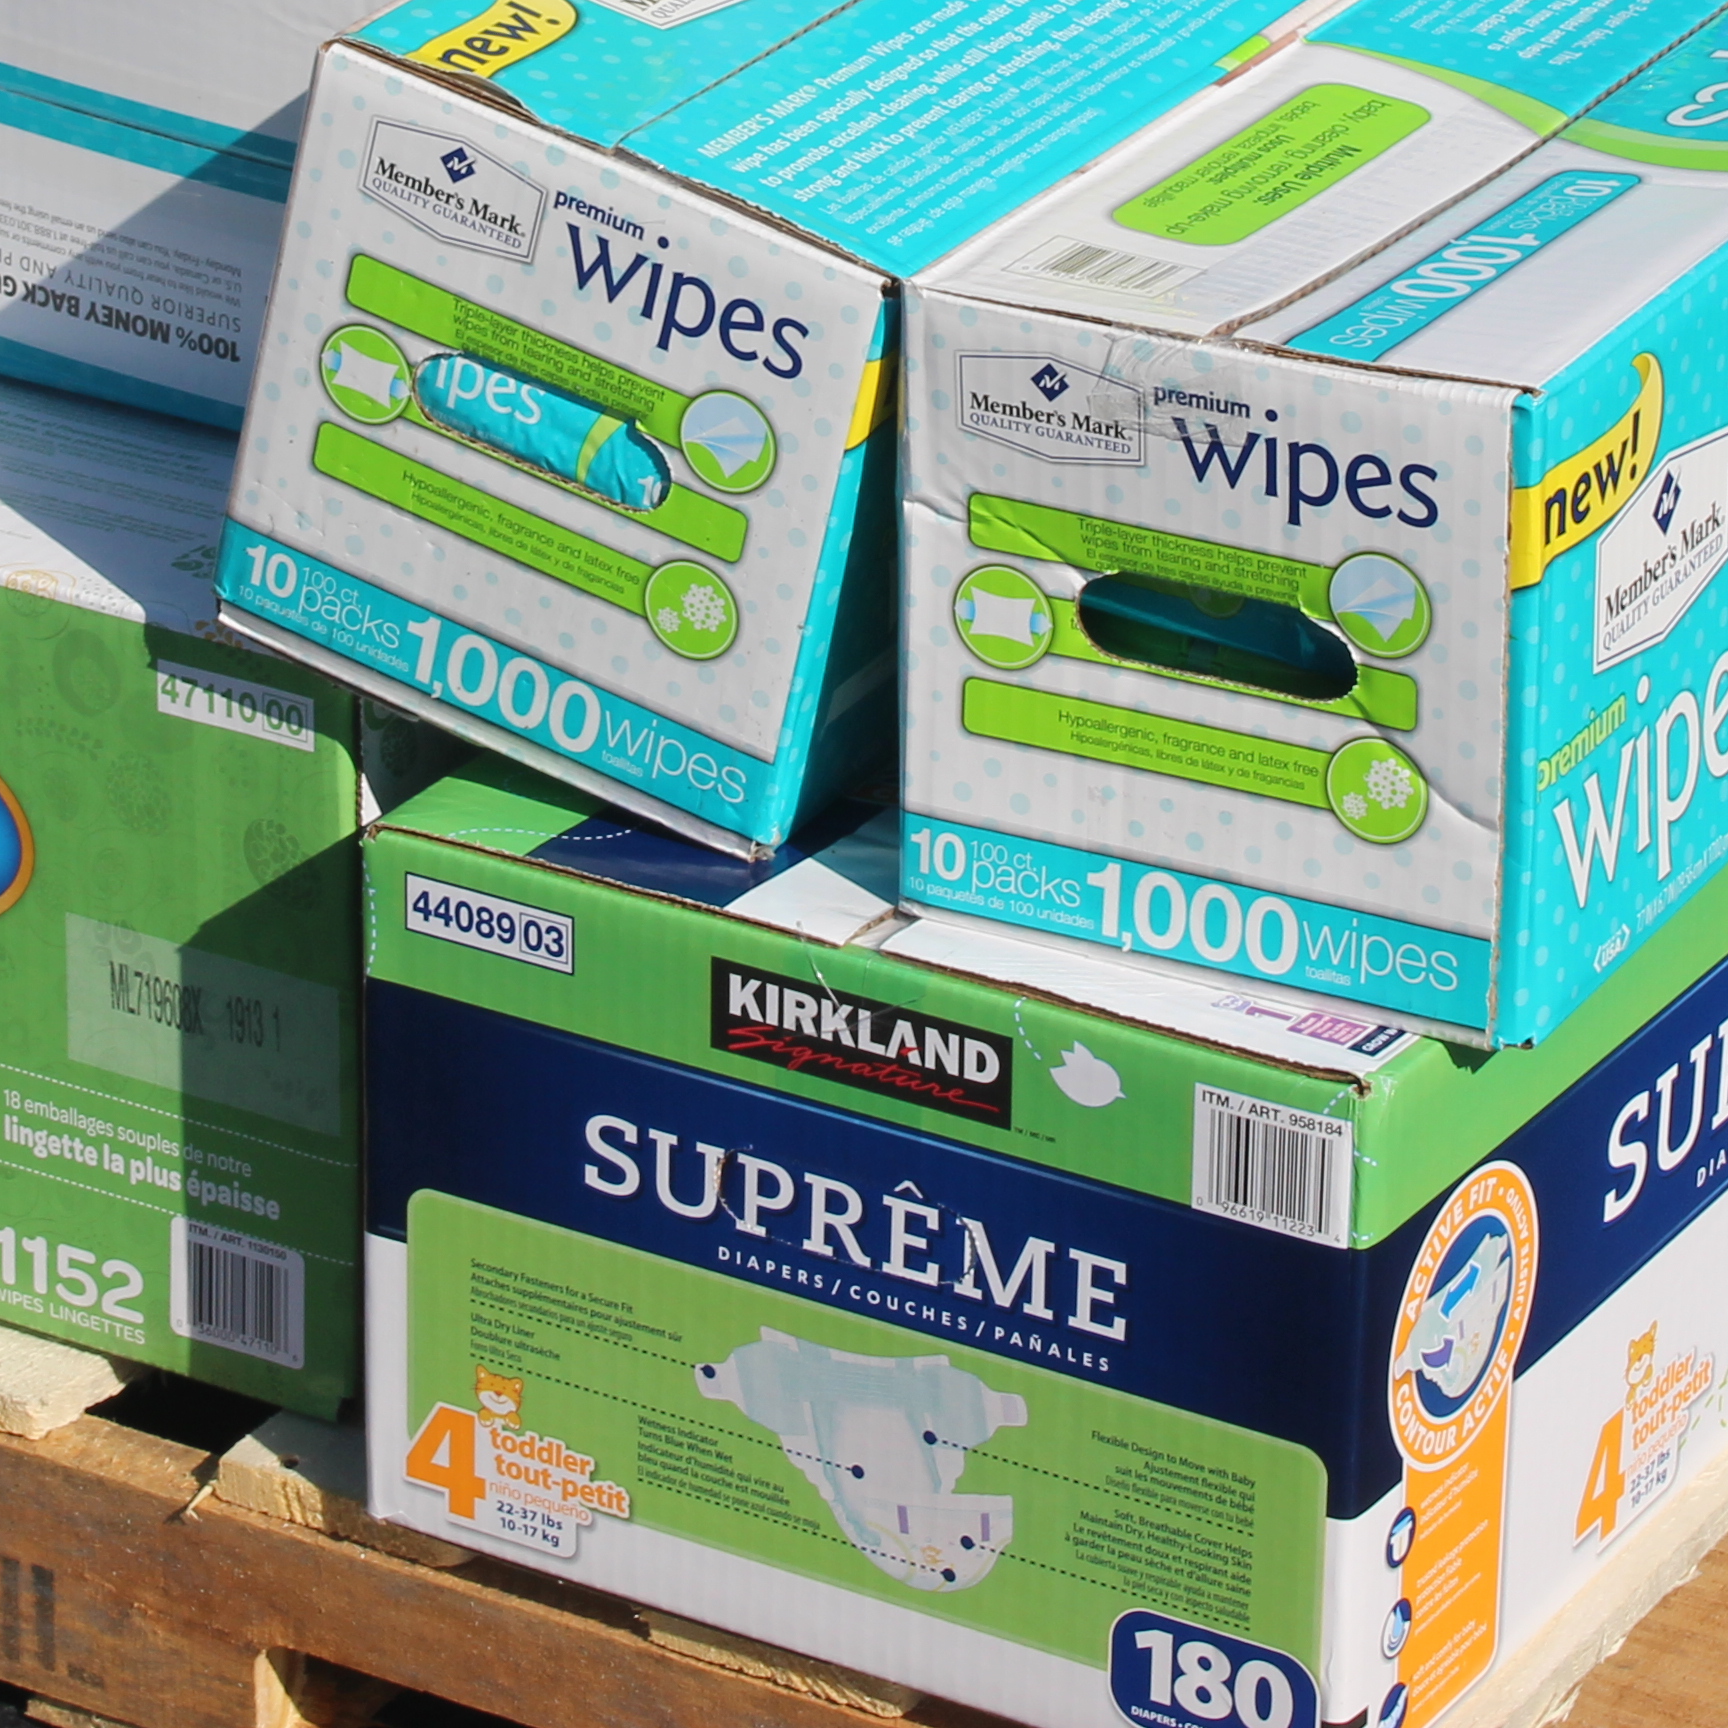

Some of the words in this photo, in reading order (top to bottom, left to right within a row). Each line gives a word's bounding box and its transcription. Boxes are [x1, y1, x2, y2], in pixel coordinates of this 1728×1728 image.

[437, 2, 547, 74] new!
[553, 190, 646, 242] premium
[22, 281, 79, 317] BACK
[84, 306, 170, 344] MONEY
[565, 222, 811, 380] wipes
[175, 326, 241, 363] 100%
[968, 413, 1034, 437] QUALITY
[1034, 426, 1132, 455] GUARANTEED
[1152, 382, 1252, 421] premium
[1170, 408, 1440, 530] wipes
[1543, 407, 1642, 548] new!
[246, 542, 297, 600] 10
[297, 589, 401, 651] packs
[407, 615, 602, 754] 1,000
[603, 715, 747, 805] wipes
[1535, 694, 1627, 803] premium
[909, 828, 967, 883] 10
[969, 855, 1083, 910] packs
[1085, 862, 1301, 978] 1,000
[1303, 916, 1460, 993] wipes
[727, 973, 1003, 1085] KIRKLAND
[724, 1024, 1000, 1115] Signature
[1202, 1089, 1234, 1109] ITM.
[1248, 1103, 1284, 1123] ART.
[1289, 1113, 1343, 1137] 958184
[582, 1110, 1130, 1345] SUPRÊME
[48, 1299, 146, 1346] LINGETTES
[717, 1247, 825, 1297] DIAPERS
[849, 1280, 969, 1334] COUCHES
[993, 1317, 1111, 1374] PAÑALES
[1629, 1352, 1695, 1424] toddler
[1631, 1363, 1711, 1450] tout-petit
[405, 1403, 486, 1521] 4
[489, 1426, 592, 1476] toddler
[1091, 1430, 1129, 1451] Flexible
[1131, 1442, 1165, 1461] Design
[1574, 1412, 1626, 1548] 4
[489, 1479, 521, 1501] niño
[523, 1490, 590, 1523] pequeño
[494, 1452, 629, 1515] tout-petit
[1134, 1628, 1294, 1728] 180
